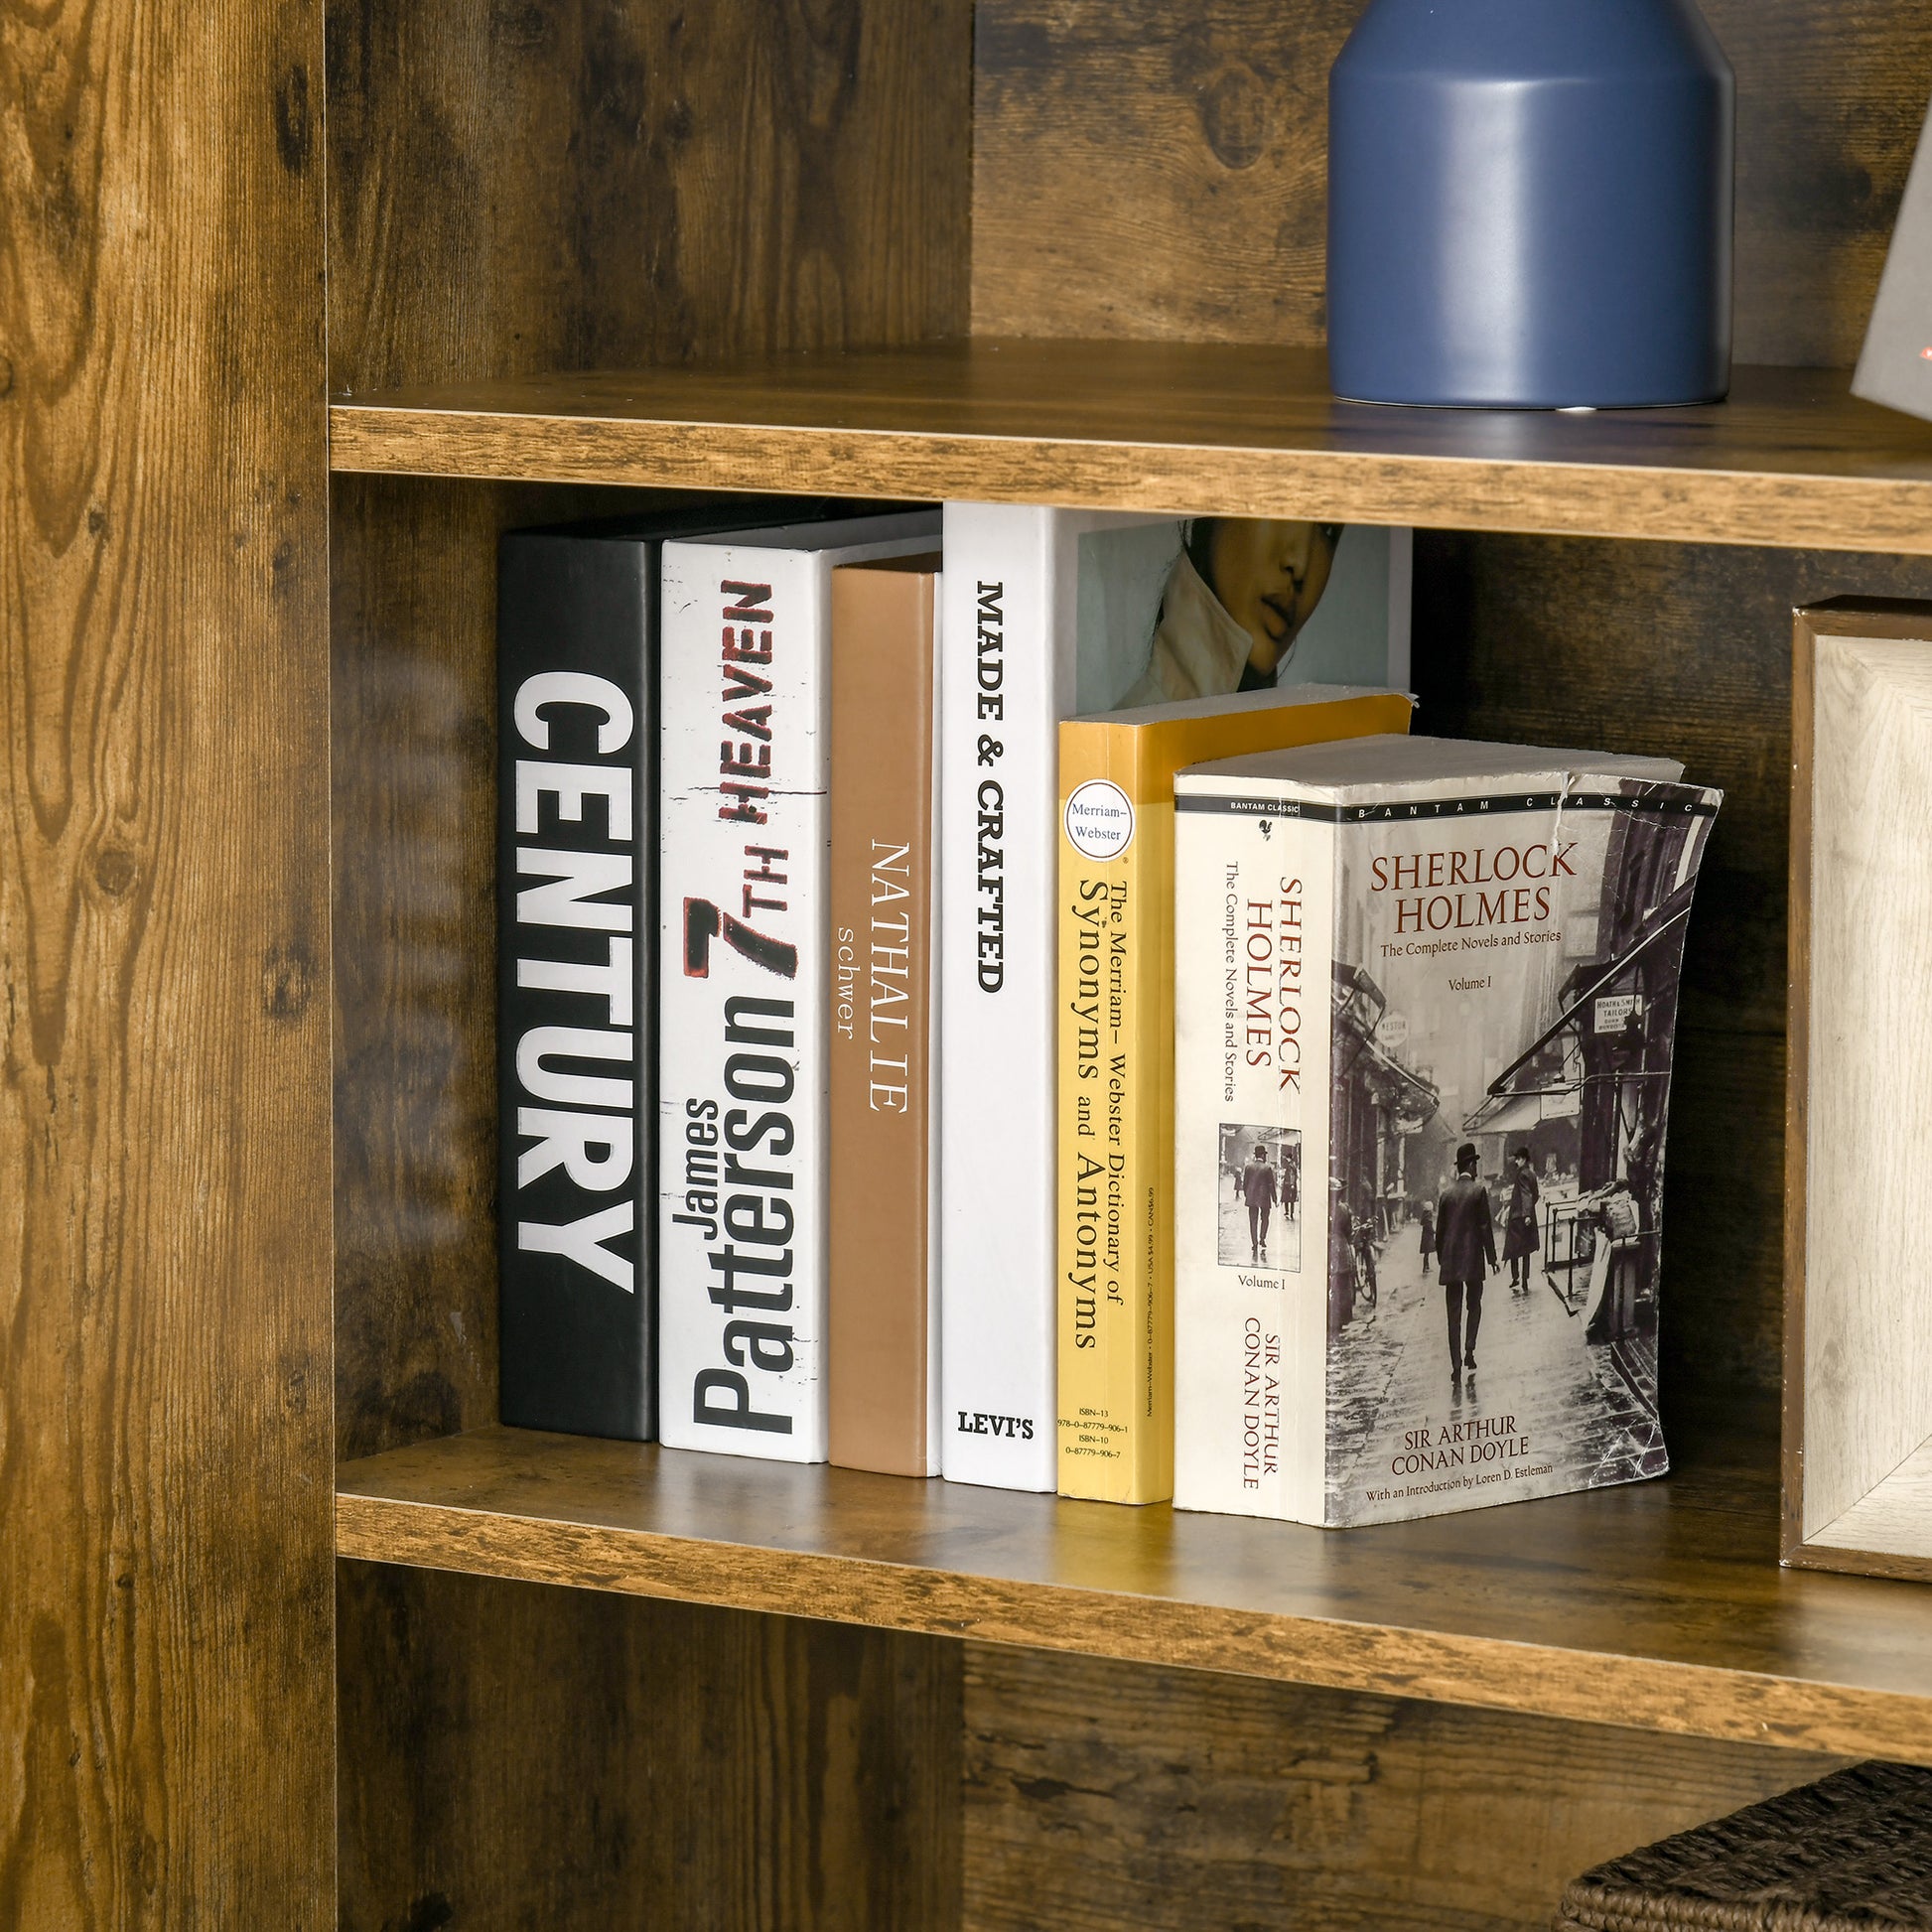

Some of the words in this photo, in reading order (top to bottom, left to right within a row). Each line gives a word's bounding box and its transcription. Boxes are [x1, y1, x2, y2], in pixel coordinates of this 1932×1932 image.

[977, 581, 1003, 721] MADE
[719, 580, 774, 825] HEAVEN
[977, 734, 1004, 766] &
[1231, 802, 1265, 811] BANTAM
[1267, 804, 1300, 813] CLASSIC
[1358, 800, 1488, 819] BANTAM
[1526, 795, 1693, 812] CLASSIC
[1075, 826, 1121, 841] Webster
[977, 779, 1004, 994] CRAFTED
[1226, 861, 1239, 890] The
[1371, 842, 1579, 893] SHERLOCK
[1111, 881, 1128, 923] The
[1394, 887, 1551, 934] HOLMES
[1222, 893, 1238, 964] Complete
[1380, 942, 1404, 958] The
[1406, 937, 1458, 958] Complete
[1461, 934, 1498, 950] Novels
[1501, 932, 1521, 946] and
[1523, 929, 1561, 944] Stories
[513, 670, 635, 1295] CENTURY
[837, 926, 861, 1040] schwer
[870, 838, 910, 1114] NATHALIE
[1070, 880, 1109, 1079] Synonyms
[1225, 967, 1238, 1019] Novels
[1246, 898, 1273, 1067] HOLMES
[1279, 877, 1303, 1095] SHERLOCK
[1449, 976, 1485, 991] Volume
[1487, 976, 1492, 989] I
[1225, 1022, 1237, 1047] and
[1108, 1053, 1126, 1146] Webster
[1224, 1048, 1237, 1102] Stories
[1077, 1096, 1095, 1137] and
[672, 1098, 719, 1241] James
[693, 995, 796, 1436] Patterson
[1103, 1154, 1126, 1272] Dictionary
[1068, 1152, 1106, 1349] Antonyms
[1107, 1280, 1124, 1306] of
[1238, 1275, 1279, 1290] Volume
[1281, 1279, 1286, 1291] I
[1244, 1316, 1261, 1407] CONAN
[1265, 1332, 1281, 1366] SIR
[957, 1411, 1034, 1440] LEVI'S
[1264, 1376, 1280, 1475] ARTHUR
[1404, 1429, 1432, 1450] SIR
[1438, 1416, 1517, 1446] ARTHUR
[1243, 1414, 1260, 1490] DOYLE
[1392, 1447, 1464, 1476] CONAN
[1469, 1436, 1529, 1463] DOYLE
[1366, 1485, 1391, 1501] With
[1406, 1478, 1461, 1497] Introduction
[1462, 1476, 1473, 1490] by
[1475, 1472, 1501, 1485] Loren
[1503, 1469, 1513, 1481] D.
[1515, 1463, 1554, 1479] Estleman
